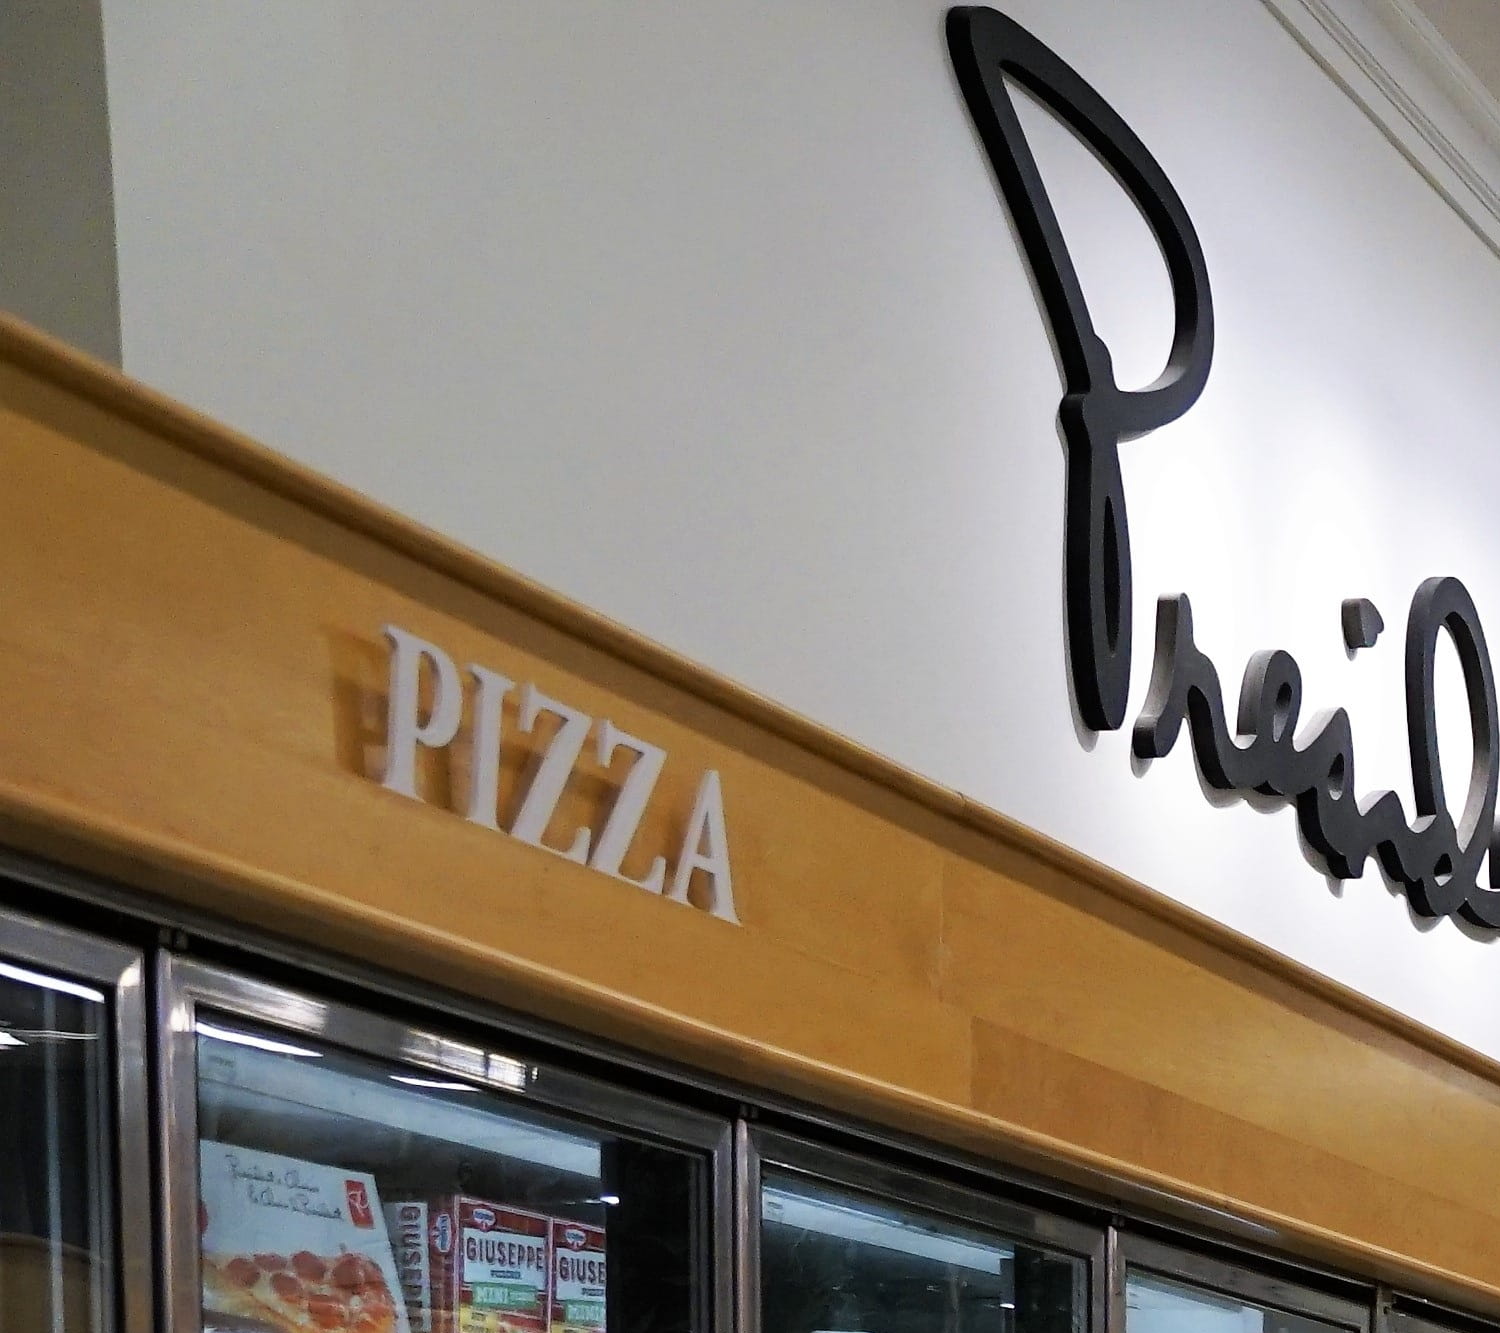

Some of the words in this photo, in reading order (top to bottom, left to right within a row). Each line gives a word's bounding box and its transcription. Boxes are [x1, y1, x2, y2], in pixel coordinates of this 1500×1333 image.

[382, 623, 743, 926] PIZZA
[466, 1237, 544, 1269] GIUSEPPE
[559, 1255, 606, 1283] GIUSE
